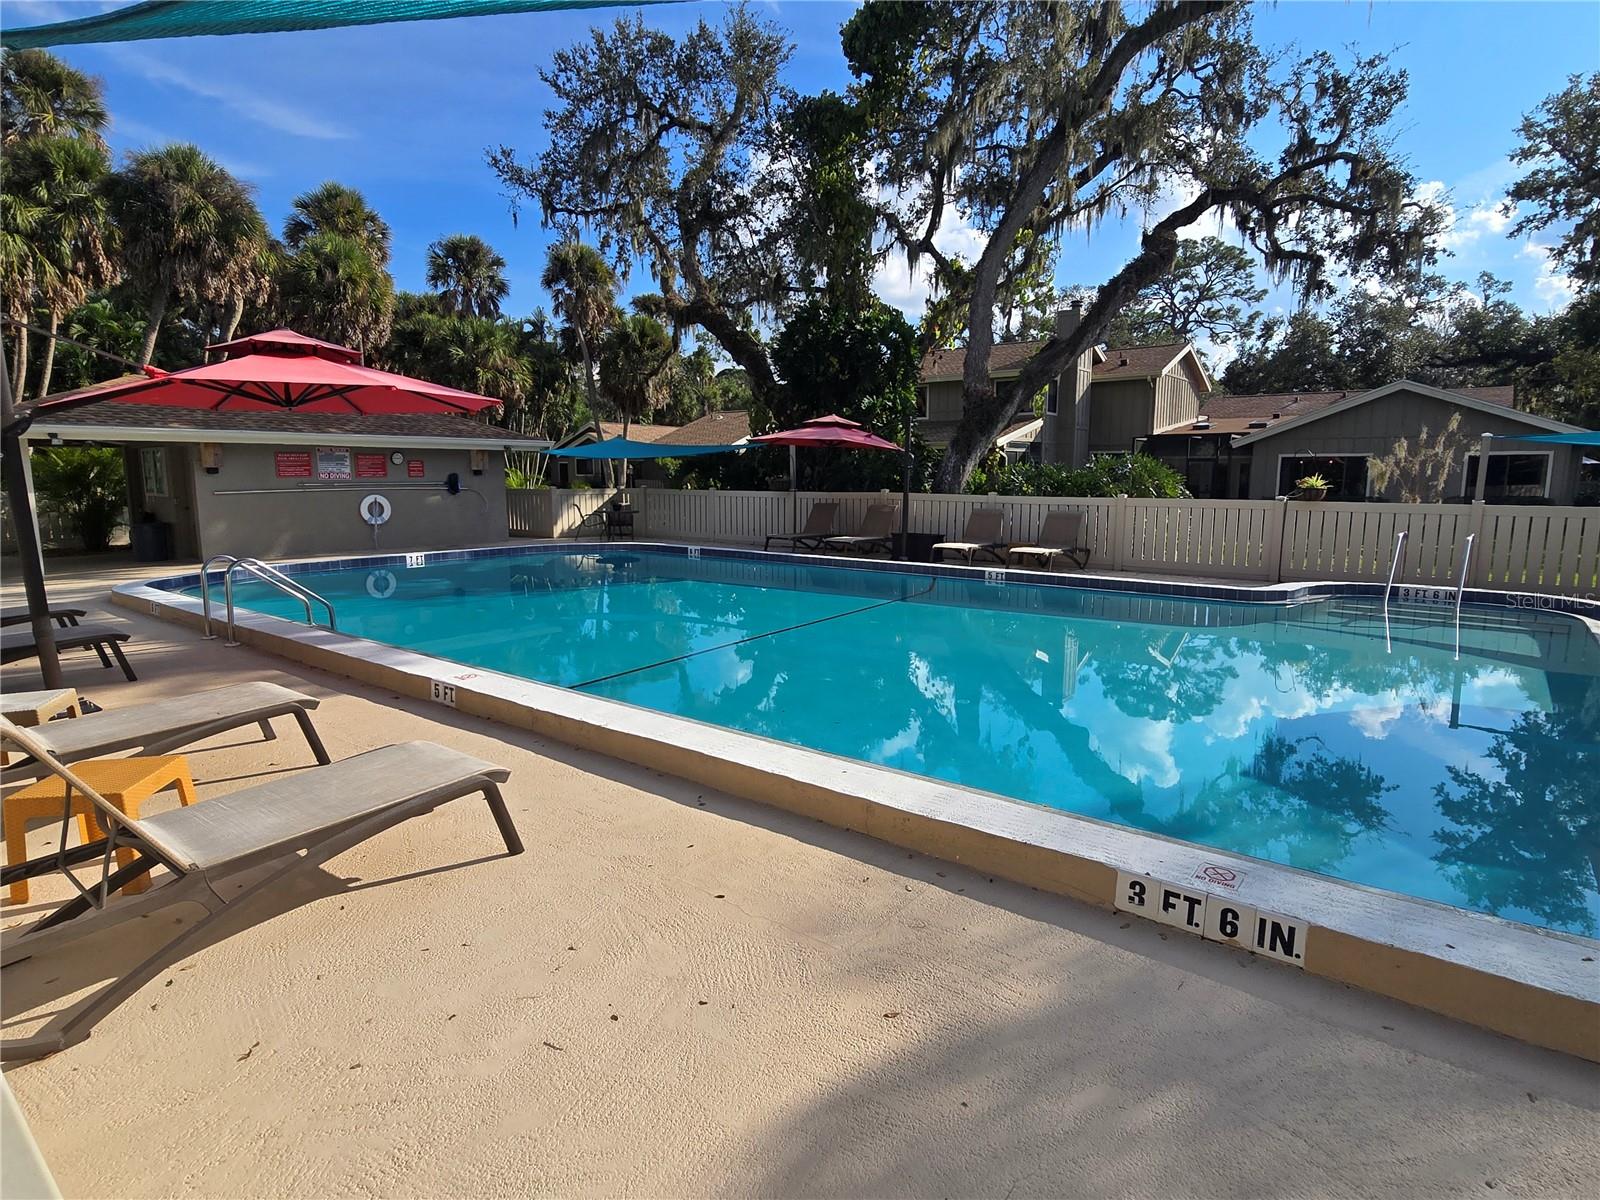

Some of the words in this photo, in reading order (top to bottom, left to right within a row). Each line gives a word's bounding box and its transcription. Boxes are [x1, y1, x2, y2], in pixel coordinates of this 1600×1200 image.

[1403, 588, 1410, 597] 3
[1433, 590, 1440, 599] 6
[434, 683, 440, 698] 5
[1208, 878, 1235, 888] DIVING
[1128, 880, 1146, 906] 3
[1162, 889, 1202, 928] FT.
[1219, 908, 1240, 938] 6
[1257, 917, 1301, 960] IN.
